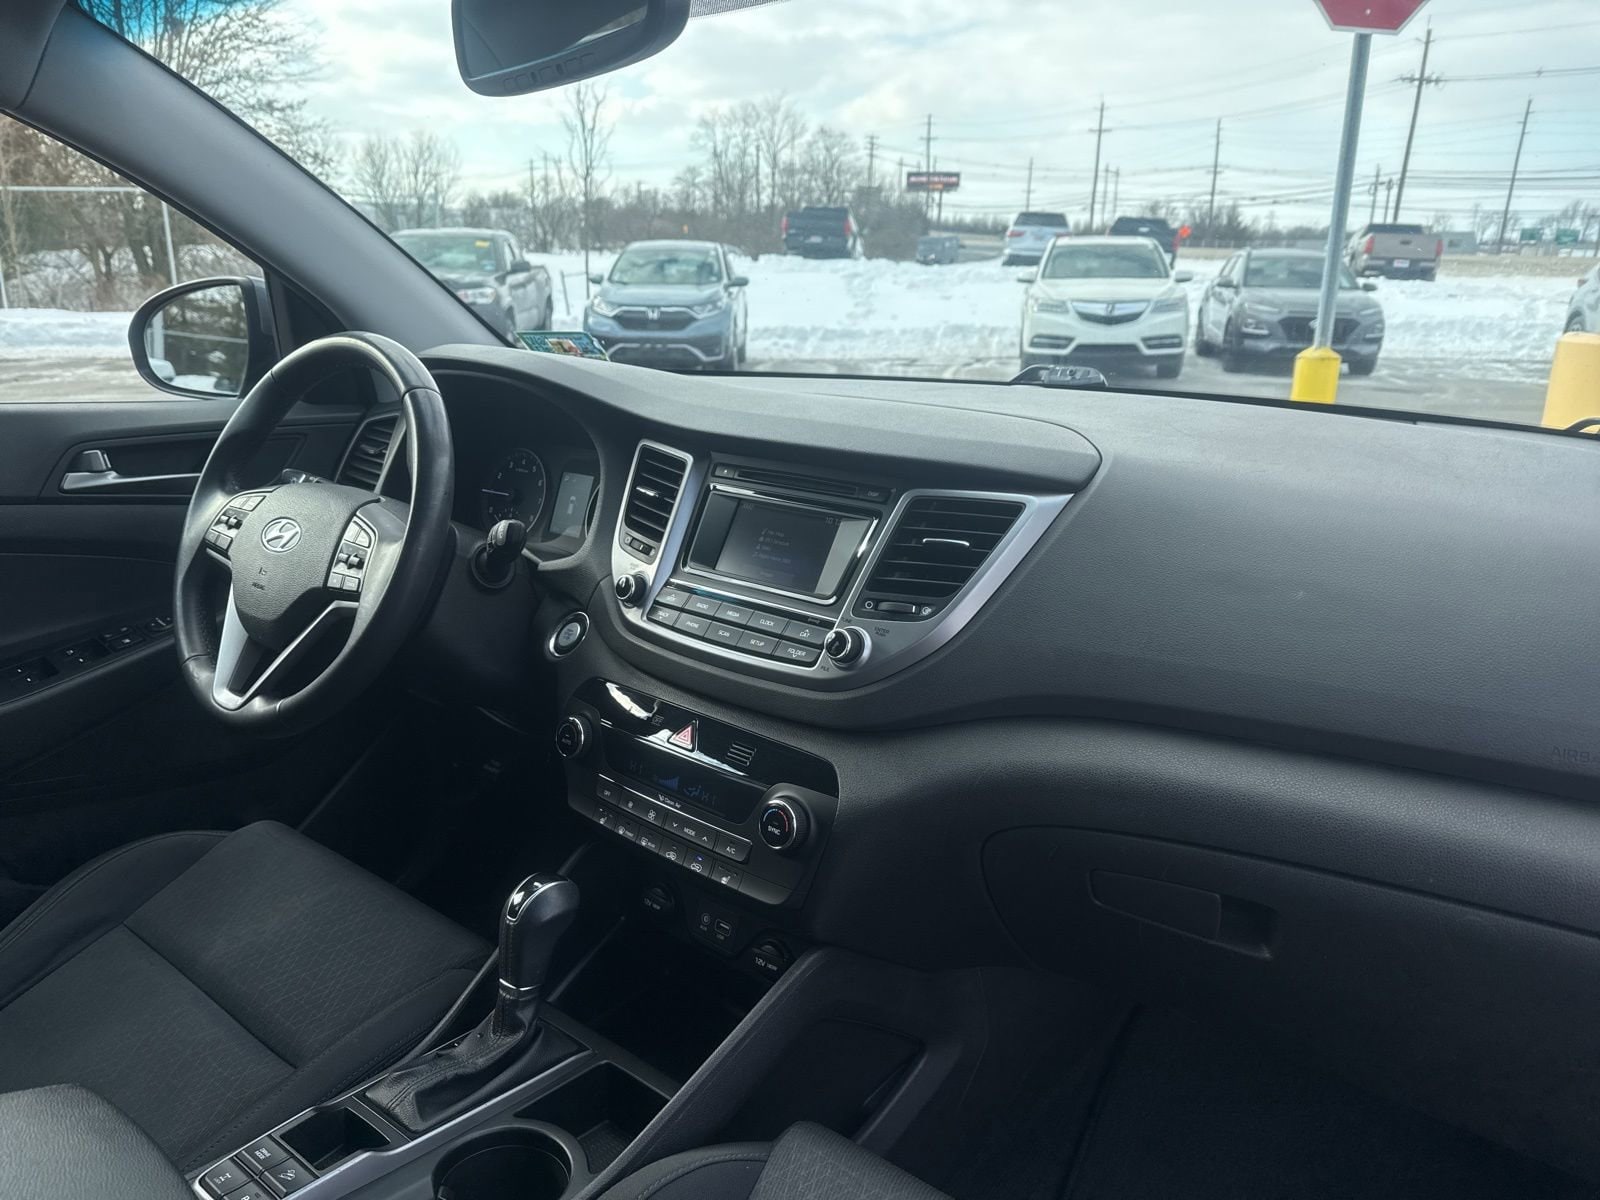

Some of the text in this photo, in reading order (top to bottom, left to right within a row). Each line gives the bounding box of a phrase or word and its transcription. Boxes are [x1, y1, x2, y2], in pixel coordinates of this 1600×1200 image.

[759, 618, 775, 627] CLOCK
[718, 629, 730, 637] SCAN
[749, 638, 765, 647] SETUP
[787, 647, 807, 656] FOLDER
[683, 827, 697, 837] MODE
[767, 825, 782, 836] SYNC
[725, 845, 736, 855] A/C
[755, 956, 766, 967] 12V
